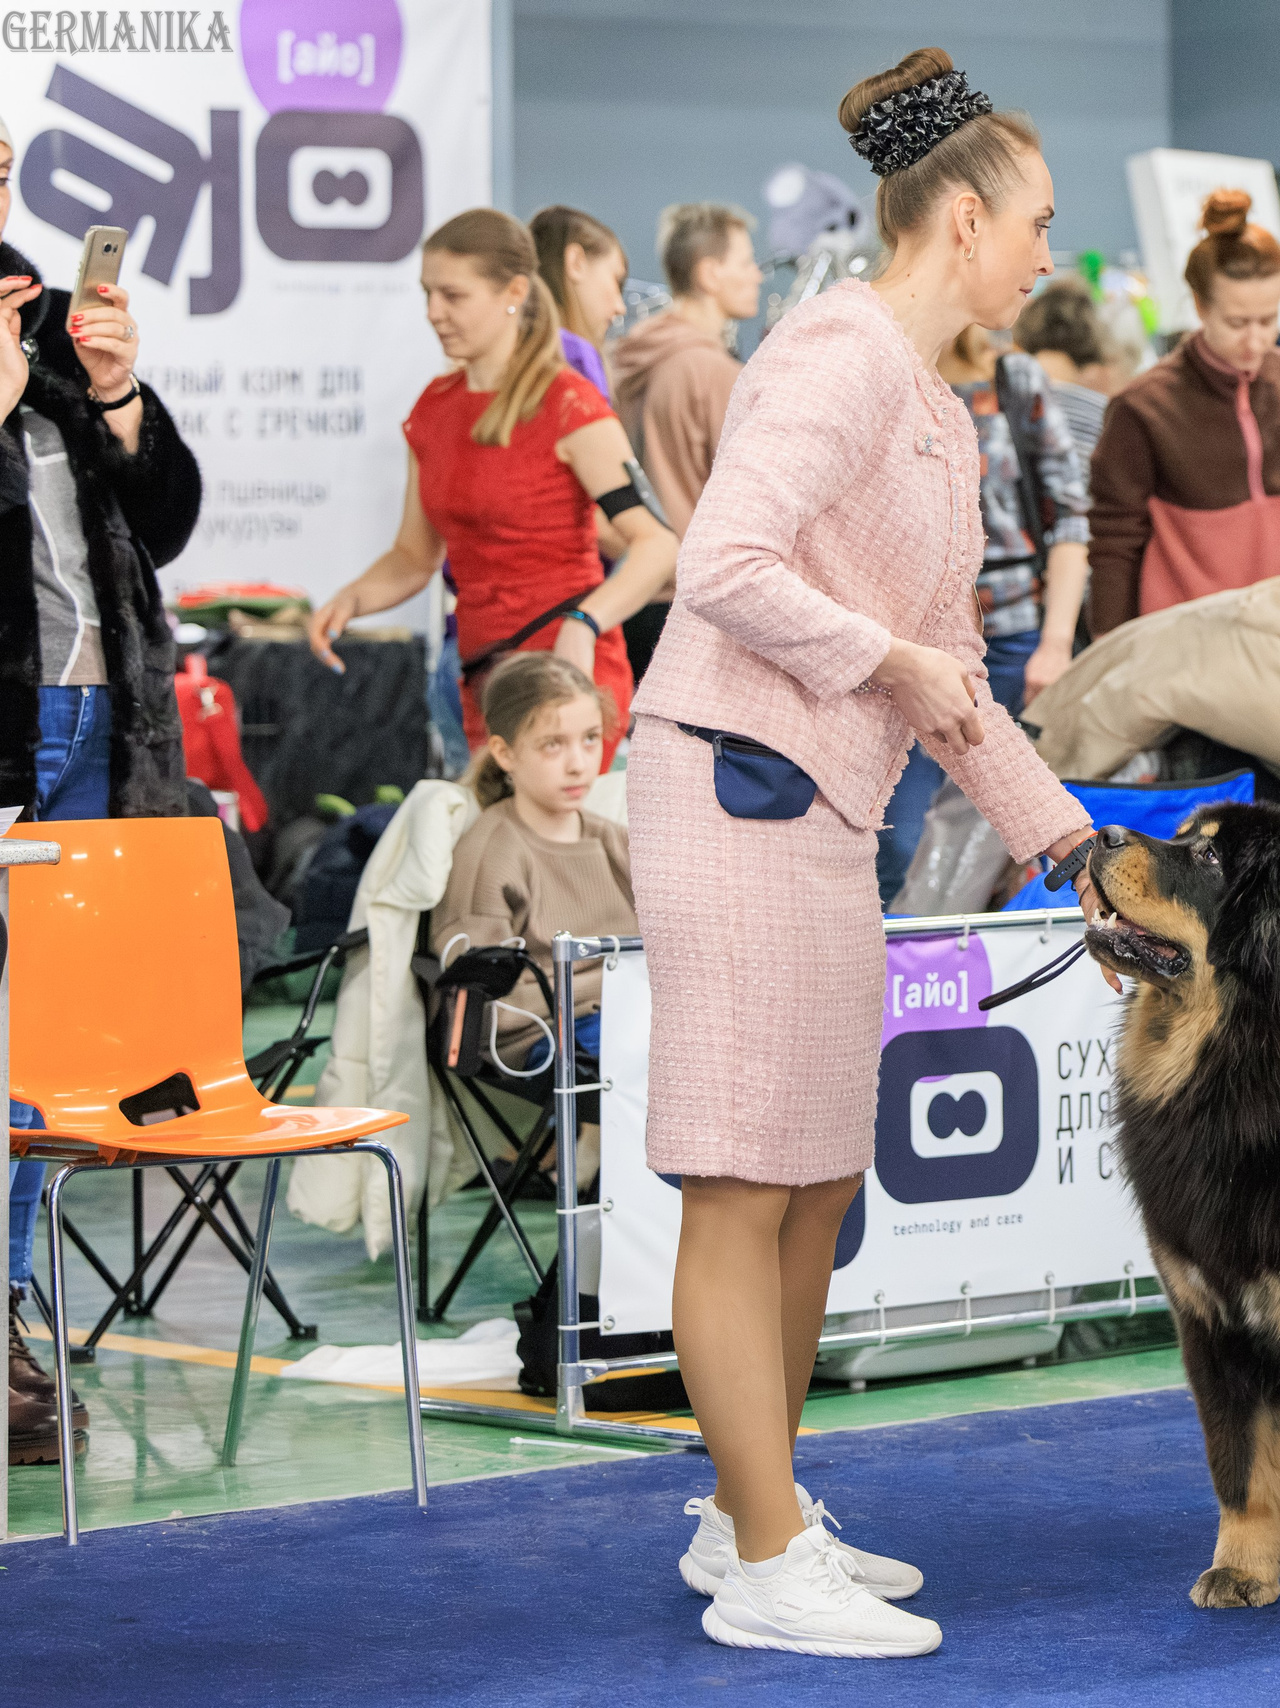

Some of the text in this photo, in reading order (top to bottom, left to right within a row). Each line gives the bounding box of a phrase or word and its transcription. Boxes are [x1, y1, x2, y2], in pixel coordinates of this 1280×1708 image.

[1057, 1038, 1113, 1080] СУХ
[1056, 1090, 1112, 1141] ДЛЯ
[1057, 1146, 1074, 1185] И
[893, 1213, 1024, 1236] technology and care
